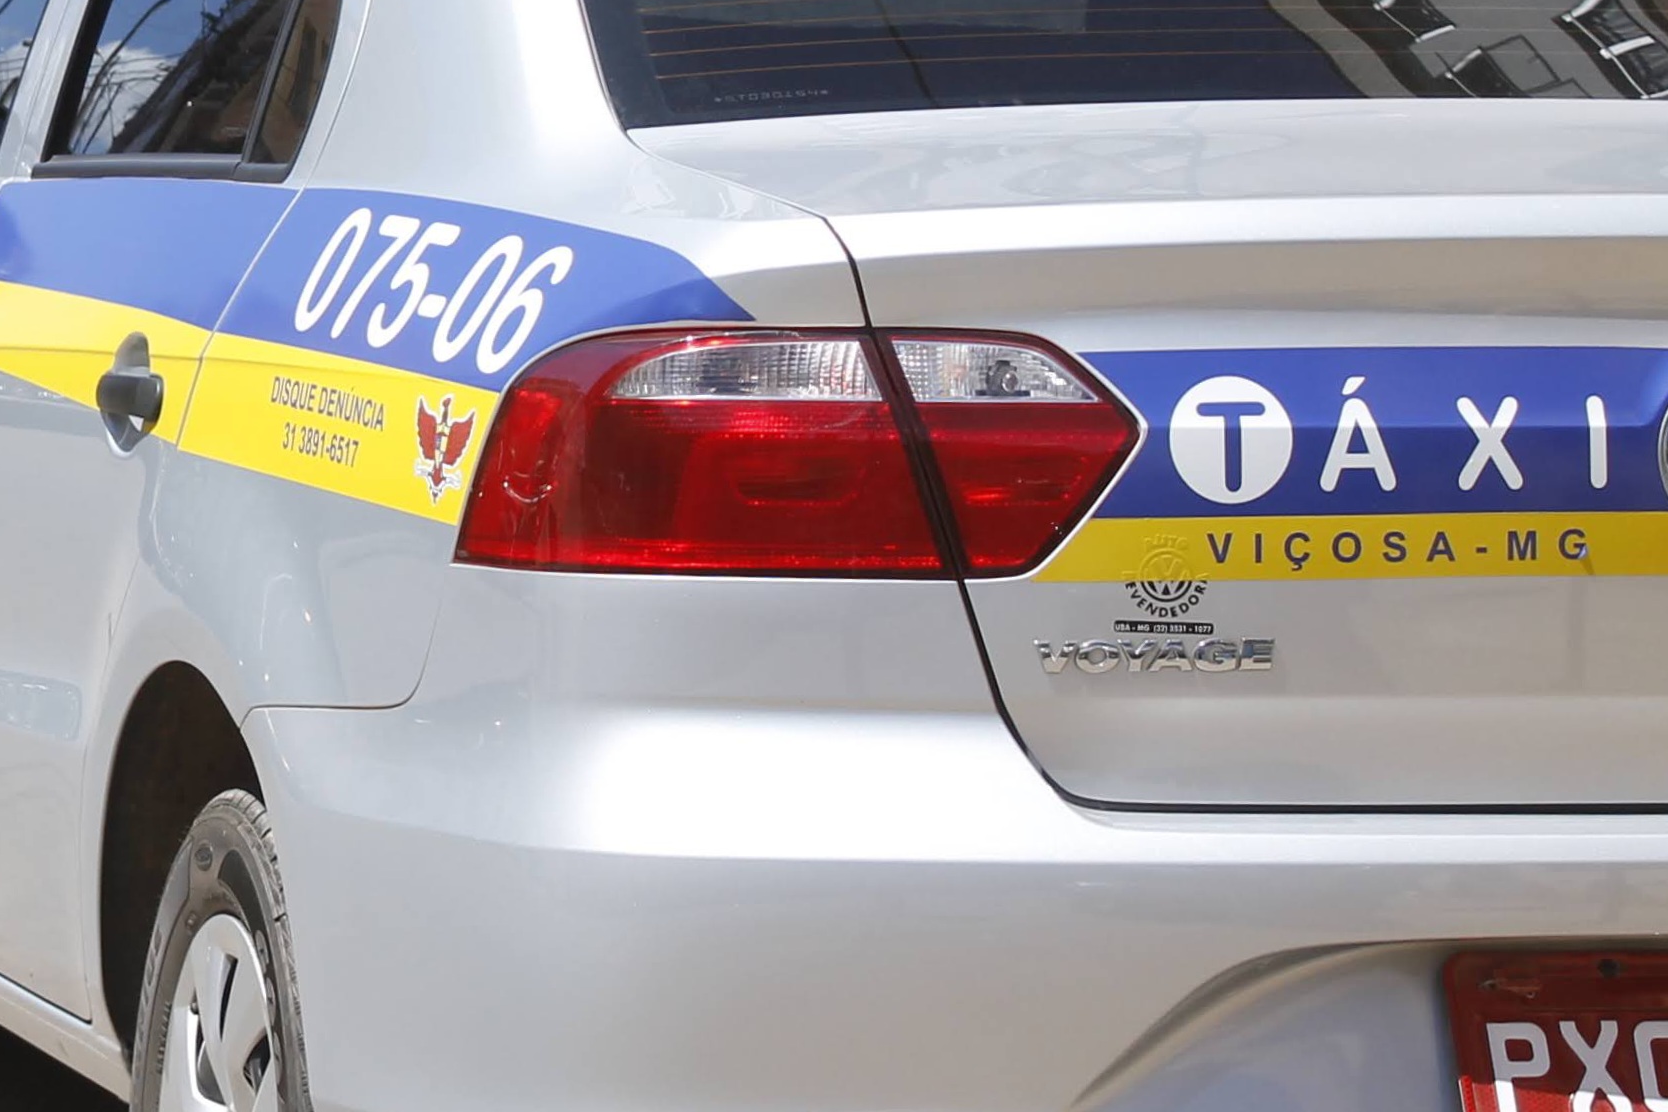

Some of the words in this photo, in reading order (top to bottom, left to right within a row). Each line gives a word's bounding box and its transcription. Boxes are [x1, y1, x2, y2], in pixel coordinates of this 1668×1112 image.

[294, 207, 574, 374] 075-06
[271, 376, 317, 413] DISQUE
[317, 387, 385, 432] DENÚNCIA
[282, 422, 297, 451] 31
[298, 426, 360, 468] 3891-6517
[1169, 376, 1608, 505] TÁXI
[1207, 528, 1587, 572] VIÇOSA-MG
[1034, 637, 1276, 675] VOYAGE
